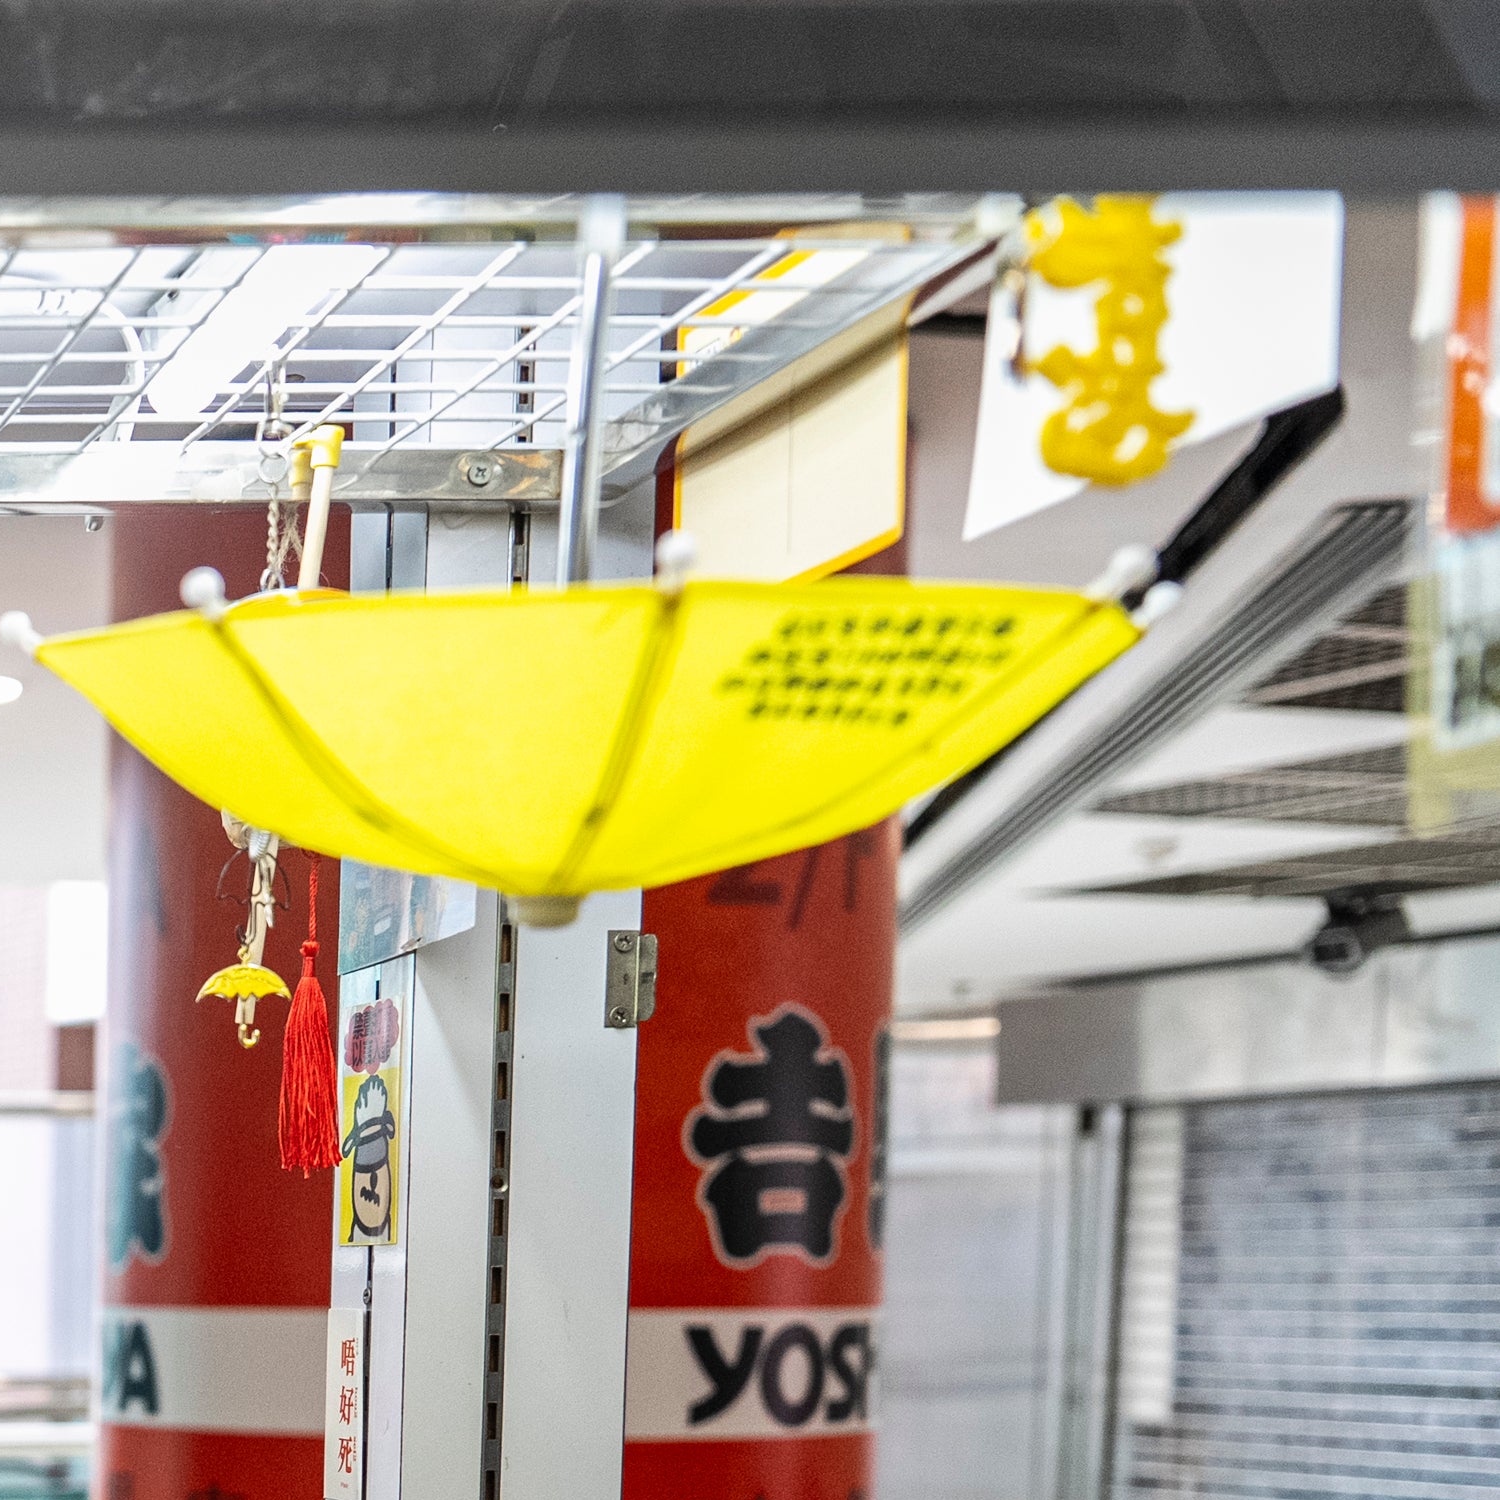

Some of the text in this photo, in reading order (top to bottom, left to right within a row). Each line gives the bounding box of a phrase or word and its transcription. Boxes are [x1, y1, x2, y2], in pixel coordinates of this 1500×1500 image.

[686, 1006, 855, 1265] 吉
[337, 1337, 356, 1475] 唔好死
